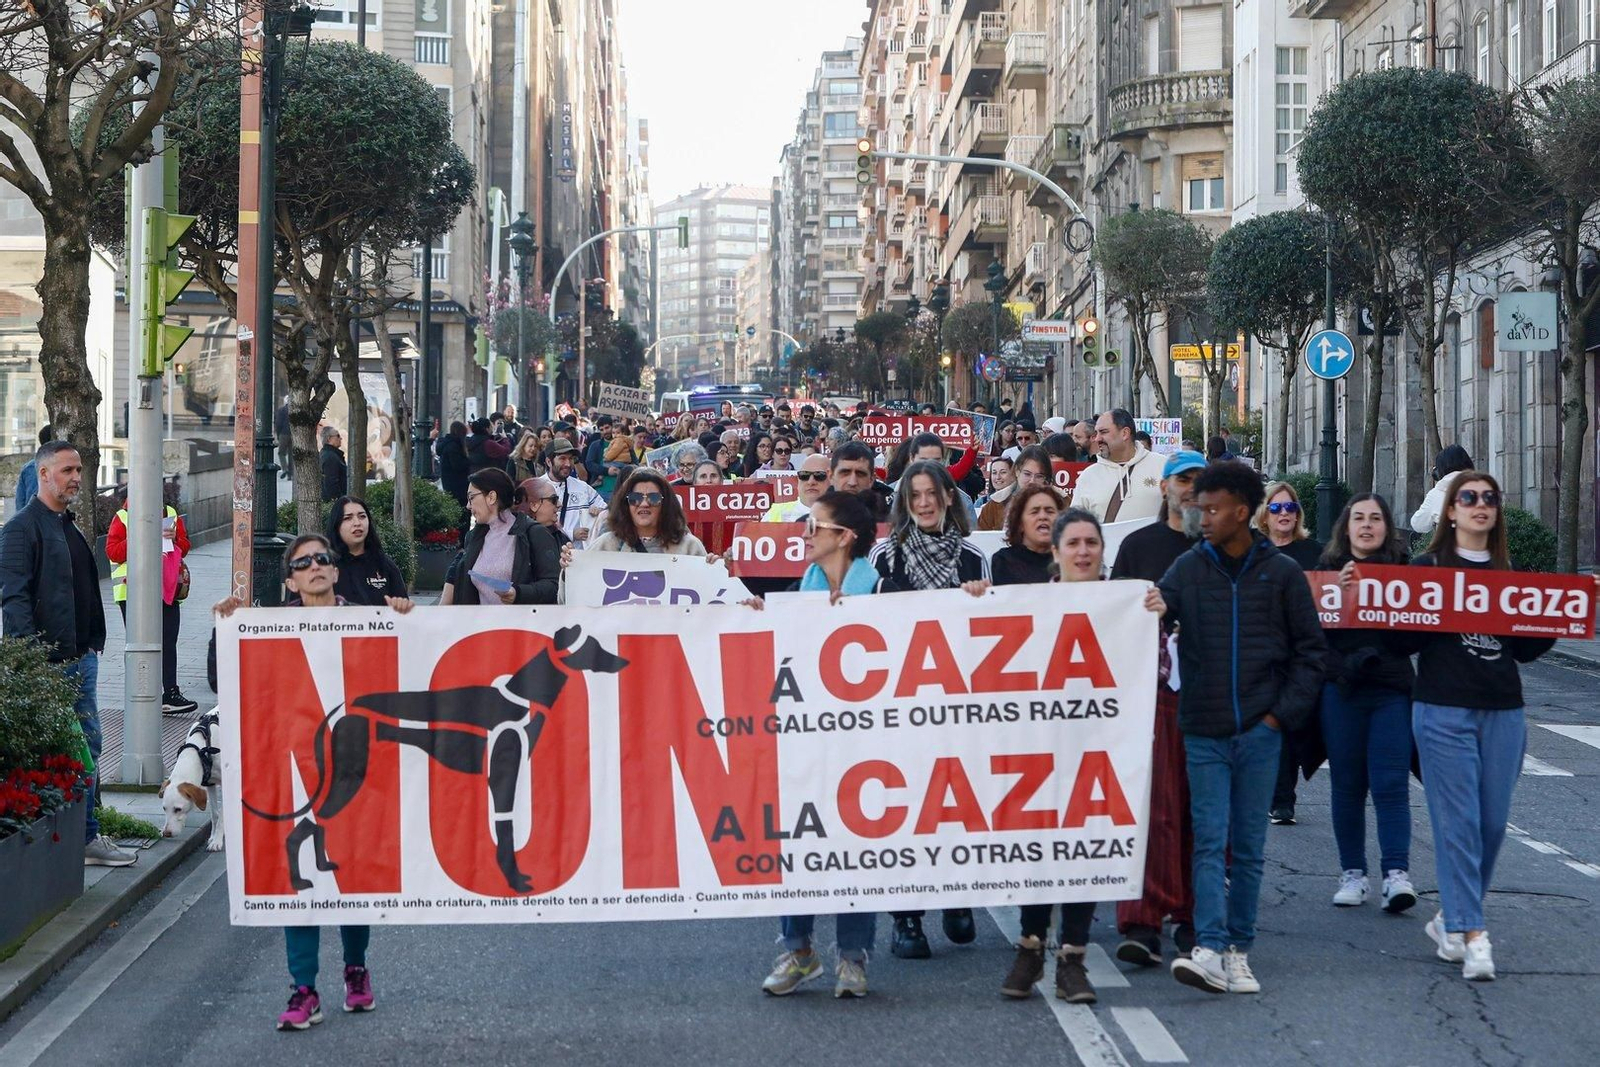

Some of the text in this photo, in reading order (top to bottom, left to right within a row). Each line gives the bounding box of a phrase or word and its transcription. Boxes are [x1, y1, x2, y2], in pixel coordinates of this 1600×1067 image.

[563, 104, 571, 167] HOSTAL
[599, 397, 648, 415] ASASINATO
[604, 386, 648, 401] A CAZA E
[863, 417, 971, 437] no a la caza
[877, 437, 901, 445] perros
[777, 479, 793, 496] la
[1055, 470, 1070, 487] o
[689, 487, 710, 510] la
[717, 492, 769, 510] caza
[733, 536, 805, 562] no a
[1320, 584, 1342, 610] a
[1358, 571, 1588, 618] no a la caza
[238, 621, 395, 634] Organiza: Plataforma NAC
[1358, 609, 1440, 628] con perros
[769, 613, 1117, 703] Á CAZA
[697, 698, 1119, 738] CON GALGOS E OUTRAS RAZAS
[239, 629, 783, 897] NON
[711, 750, 1137, 842] A LA CAZA
[736, 853, 793, 874] CON
[804, 847, 916, 872] GALGOS
[924, 846, 942, 866] Y
[951, 841, 1043, 865] OTRAS
[244, 900, 275, 910] Canto
[279, 899, 306, 910] máis
[311, 899, 369, 909] indefensa
[373, 897, 399, 908] está
[403, 897, 431, 908] unha
[436, 896, 486, 908] criatura,
[490, 895, 518, 907] máis
[522, 895, 564, 906] dereito
[568, 896, 587, 905] ten
[602, 896, 620, 905] ser
[625, 893, 685, 904] defendida
[696, 892, 738, 902] Cuanto
[742, 889, 767, 900] más
[770, 888, 829, 899] indefensa
[833, 886, 858, 897] está
[862, 887, 884, 896] una
[888, 883, 939, 895] criatura,
[943, 881, 967, 892] más
[971, 880, 1020, 891] derecho
[1024, 878, 1053, 888] tiene
[1057, 879, 1065, 887] a
[1068, 878, 1087, 887] ser
